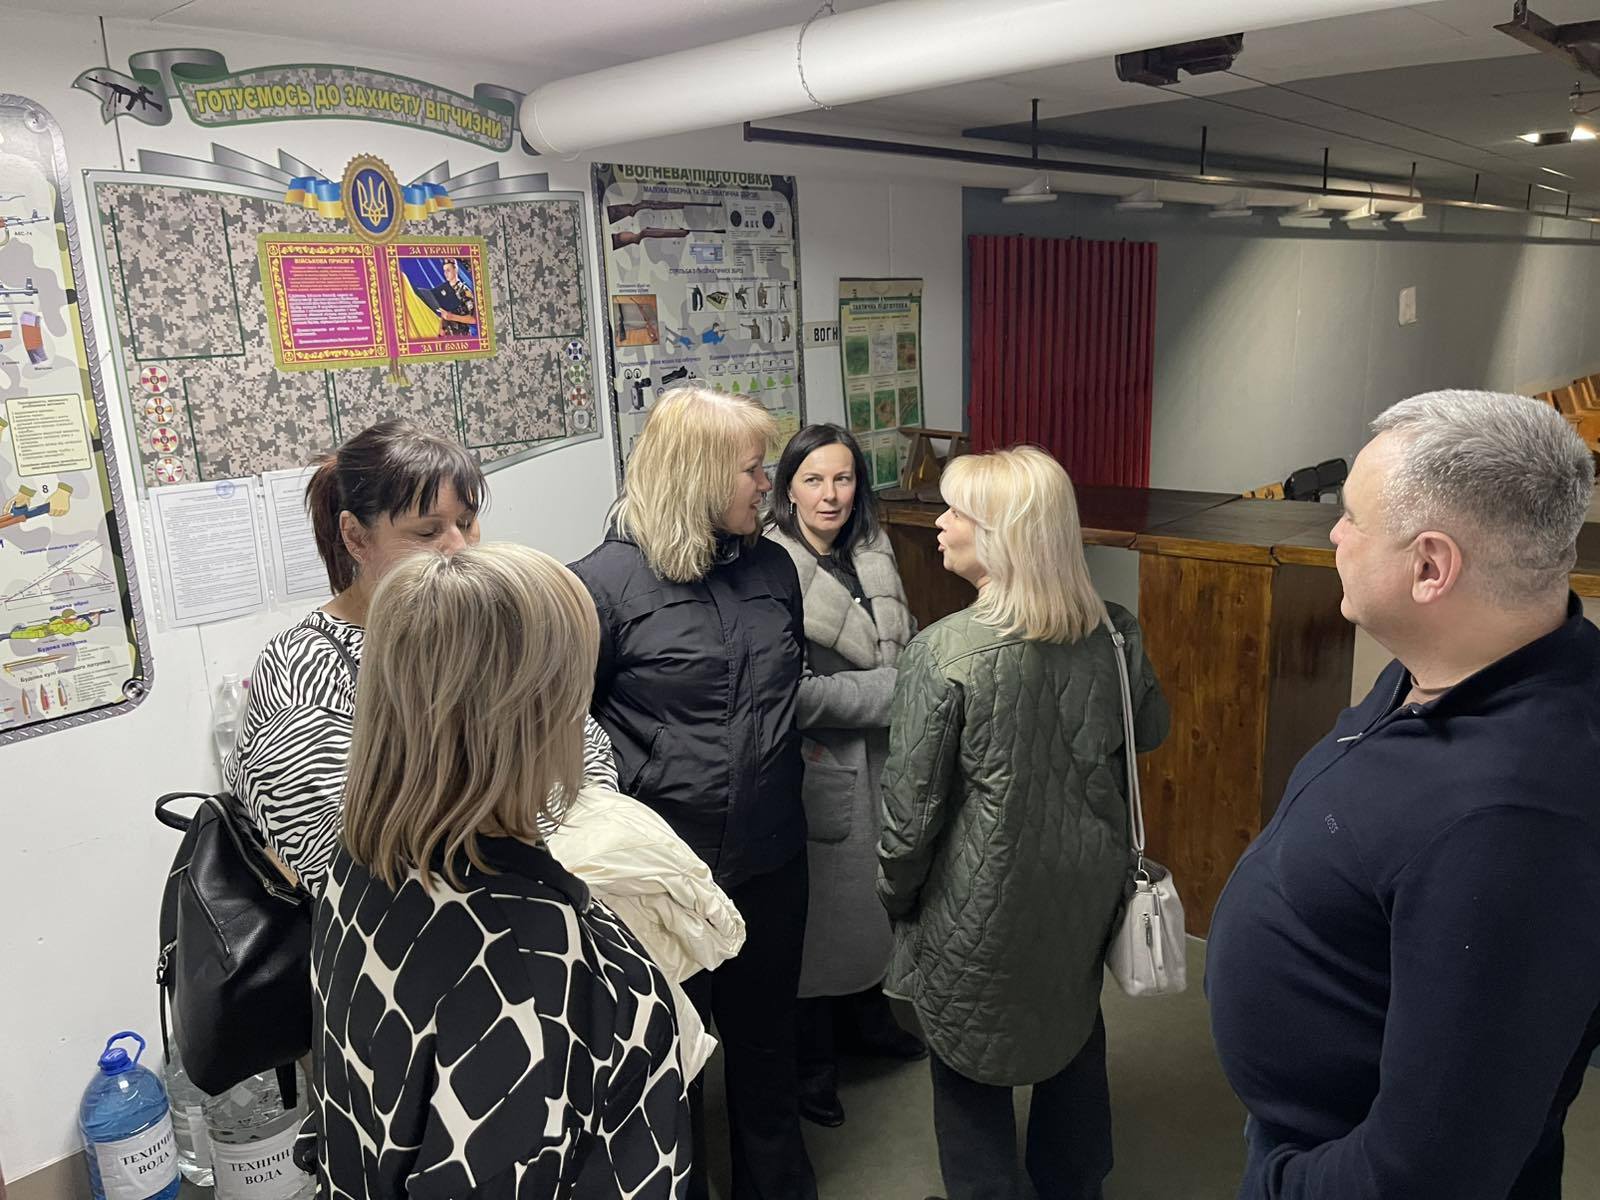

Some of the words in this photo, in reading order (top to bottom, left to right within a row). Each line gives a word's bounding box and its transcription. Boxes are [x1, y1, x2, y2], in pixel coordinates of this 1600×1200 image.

[195, 84, 311, 113] ГОТУЄМОСЬ
[314, 83, 340, 110] ДО
[343, 83, 420, 116] ЗАХИСТУ
[424, 98, 503, 140] ВІТЧИЗНИ
[625, 164, 690, 181] ВОГНЕВА
[693, 168, 771, 186] ПІДГОТОВКА
[409, 245, 421, 256] ЗА
[420, 344, 433, 353] ЗА
[42, 484, 49, 493] 8
[138, 1152, 169, 1175] ВОДА
[245, 1169, 283, 1185] ВОДА
